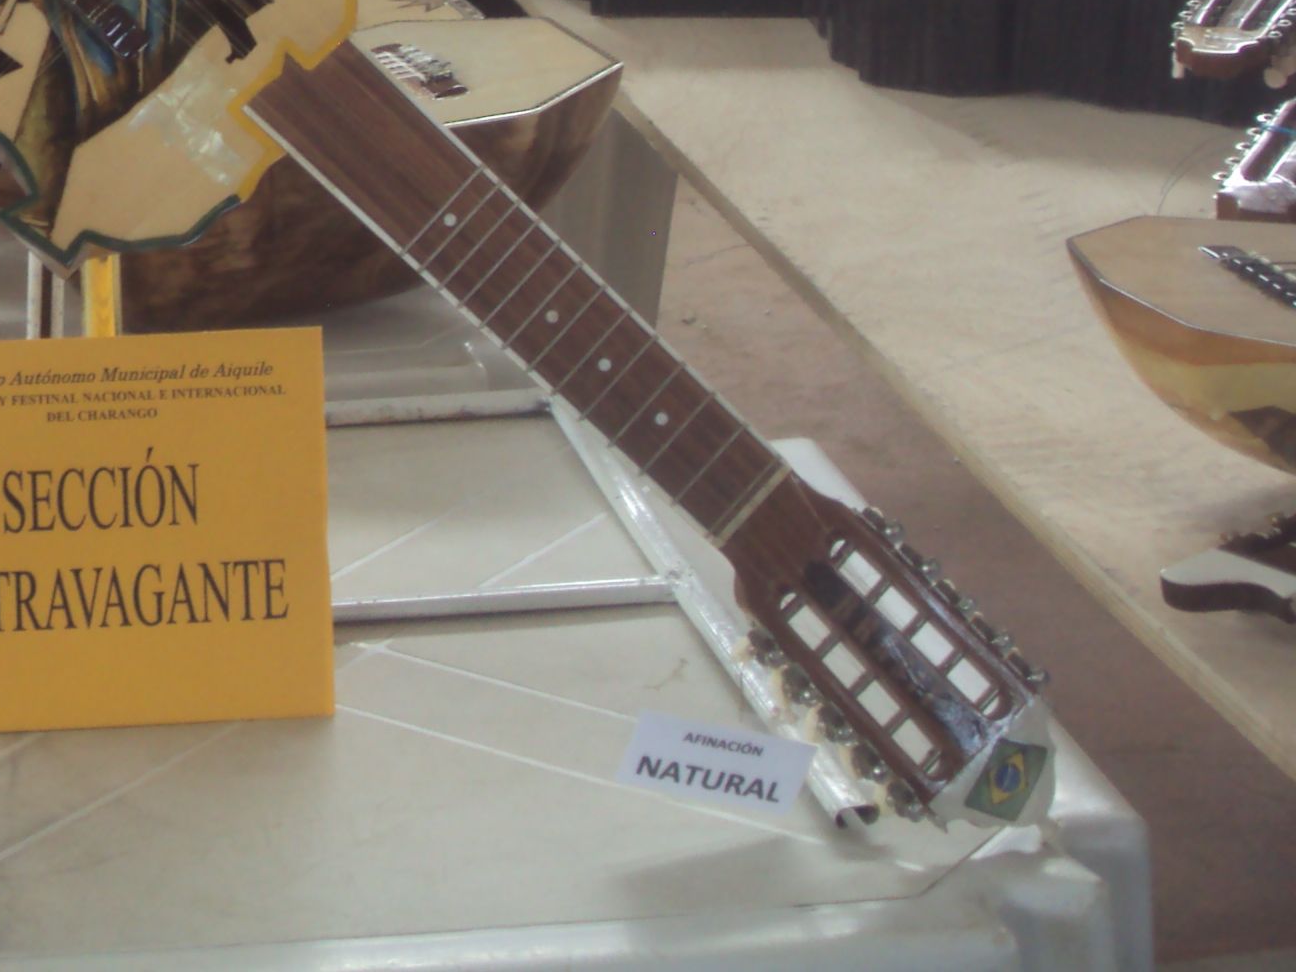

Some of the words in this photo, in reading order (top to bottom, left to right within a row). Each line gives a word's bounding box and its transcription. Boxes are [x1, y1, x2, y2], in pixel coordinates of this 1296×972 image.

[10, 369, 96, 387] Autónomo
[101, 364, 186, 384] Municipal
[189, 364, 210, 379] de
[213, 361, 274, 380] Aiquile
[82, 389, 154, 403] NACIONAL
[159, 389, 168, 401] E
[172, 384, 286, 400] INTERNACIONAL
[47, 411, 74, 423] DEL
[77, 407, 158, 422] CHARANGO
[1, 446, 200, 534] SECCIÓN
[682, 732, 764, 756] AFINACIÓN
[635, 755, 779, 803] NATURAL
